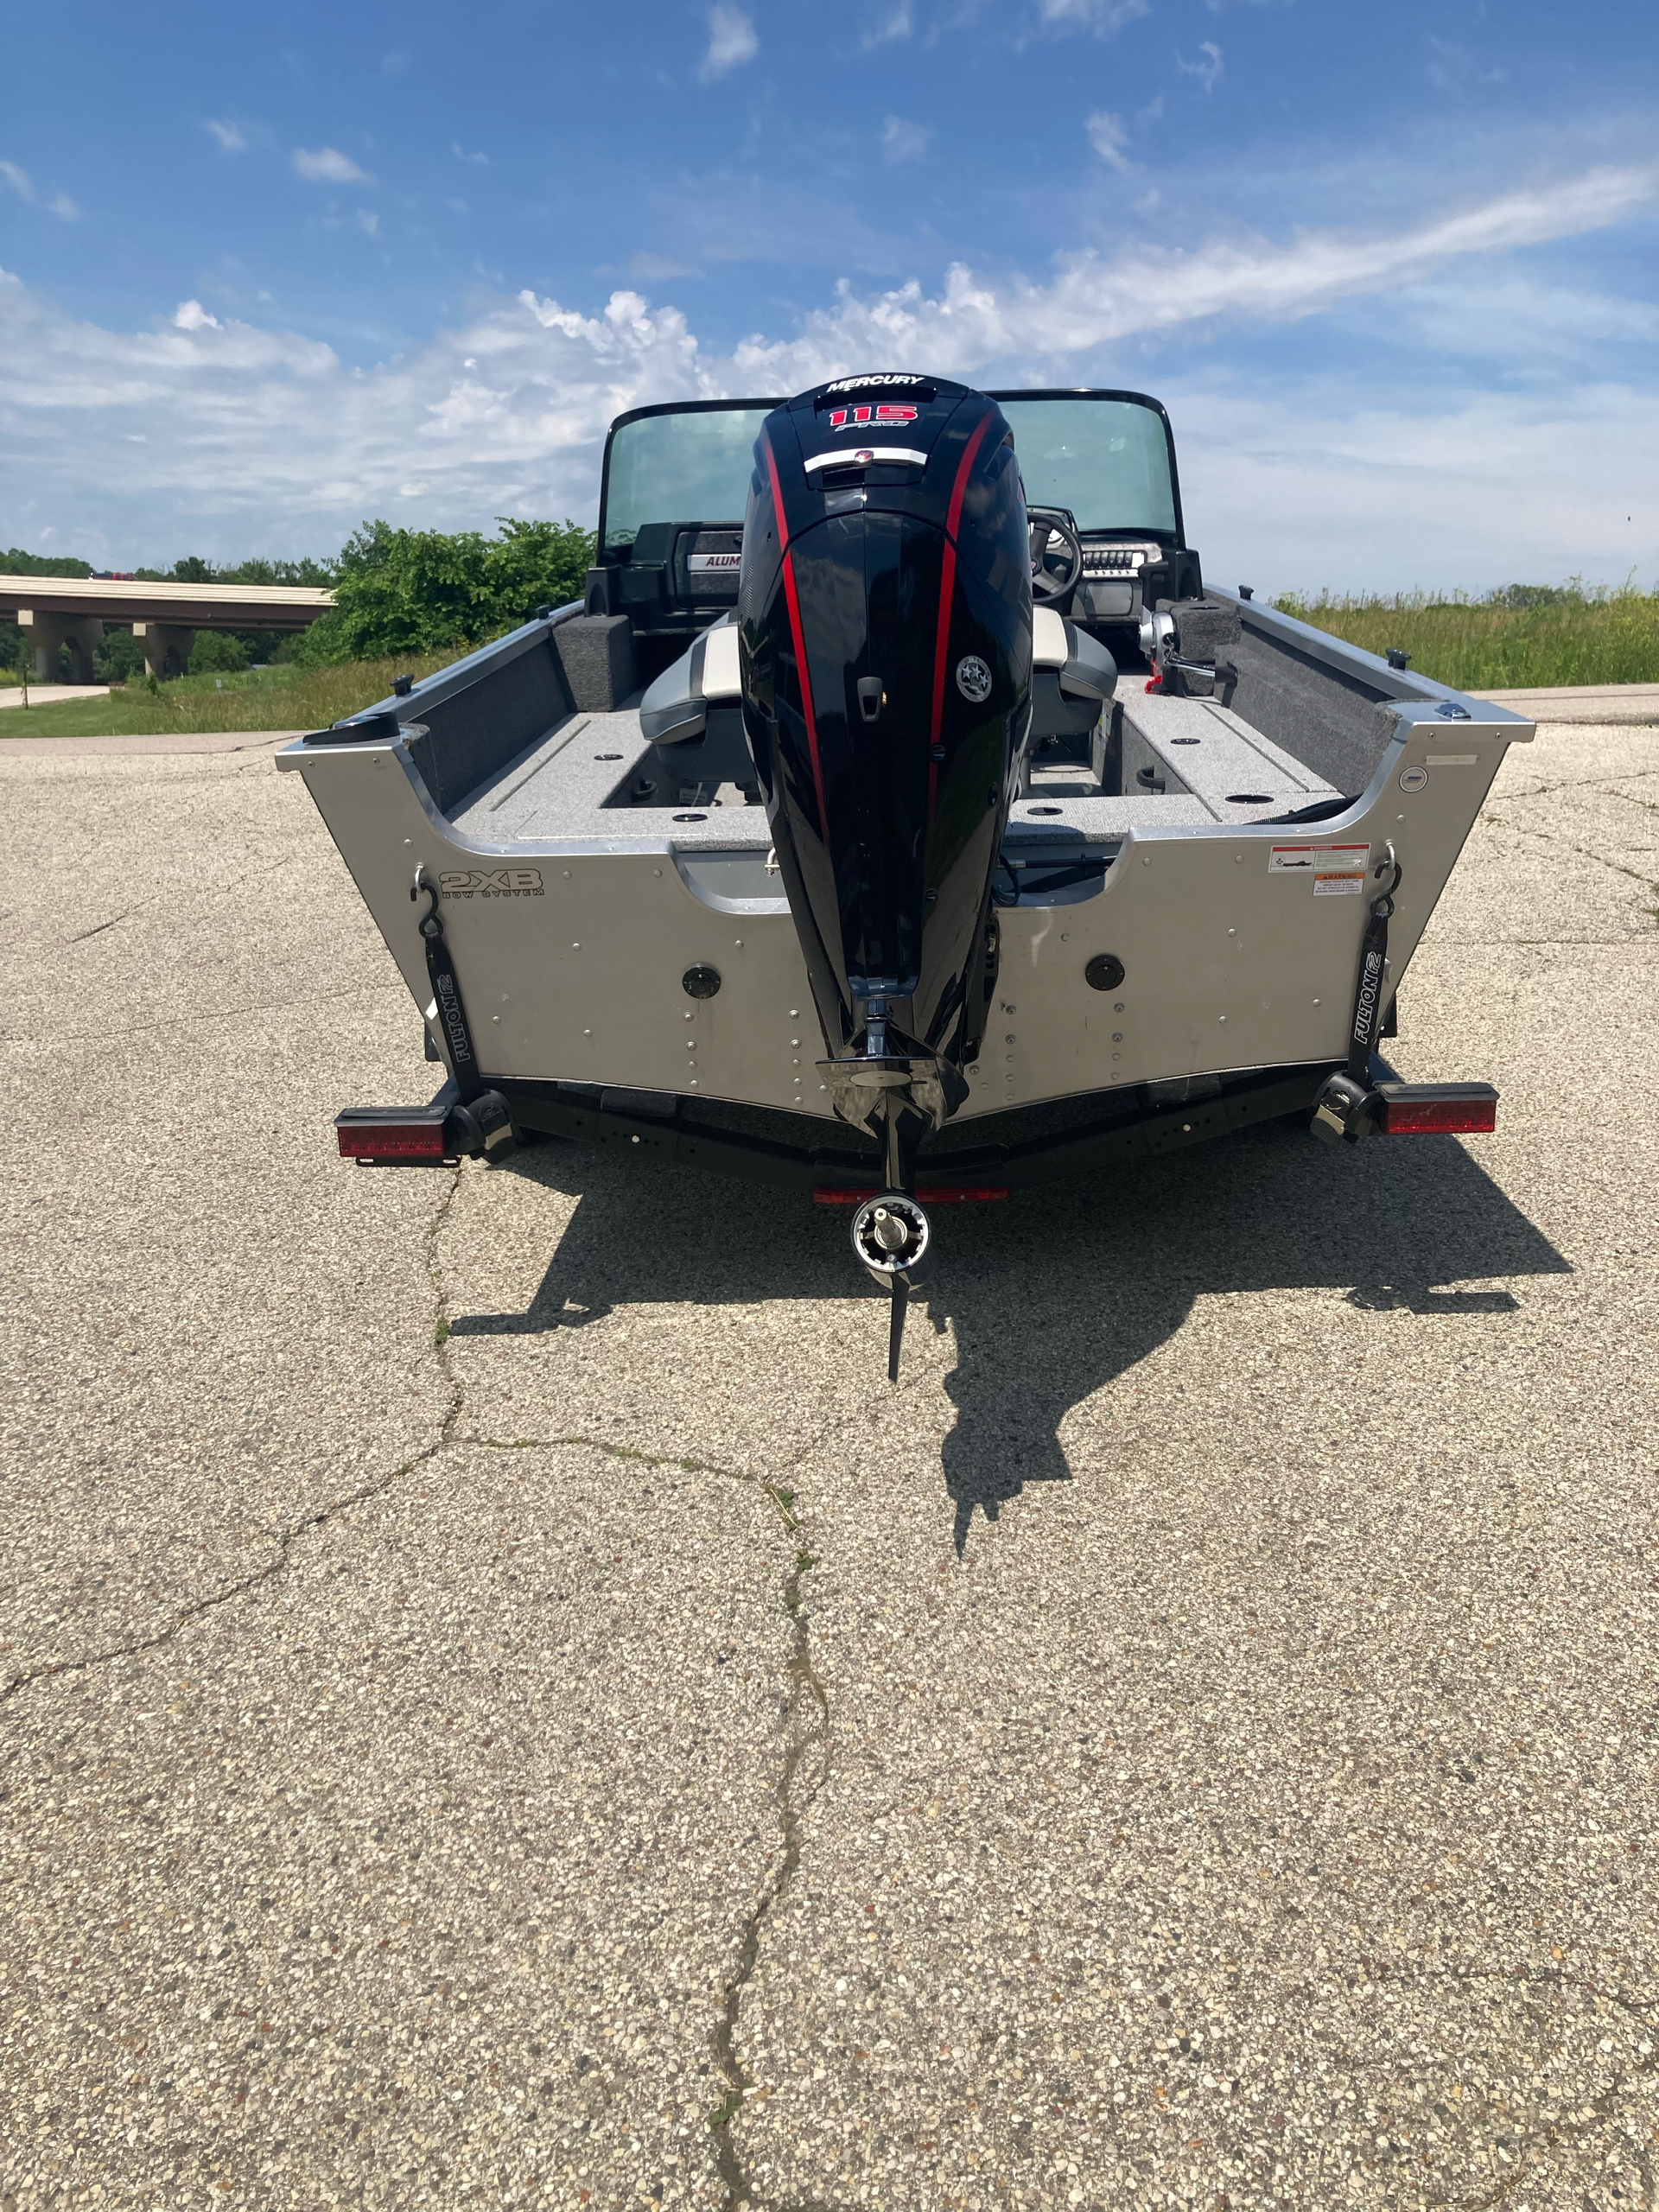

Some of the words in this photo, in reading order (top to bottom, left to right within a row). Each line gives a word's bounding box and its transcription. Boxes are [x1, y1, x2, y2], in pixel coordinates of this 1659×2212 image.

[826, 375, 925, 392] MERCURY
[829, 405, 918, 426] 115
[835, 420, 910, 432] PRO
[439, 868, 543, 893] 2XB
[482, 888, 544, 898] SYSTEM
[1354, 969, 1378, 1045] FULTON
[441, 995, 471, 1063] FULTON
